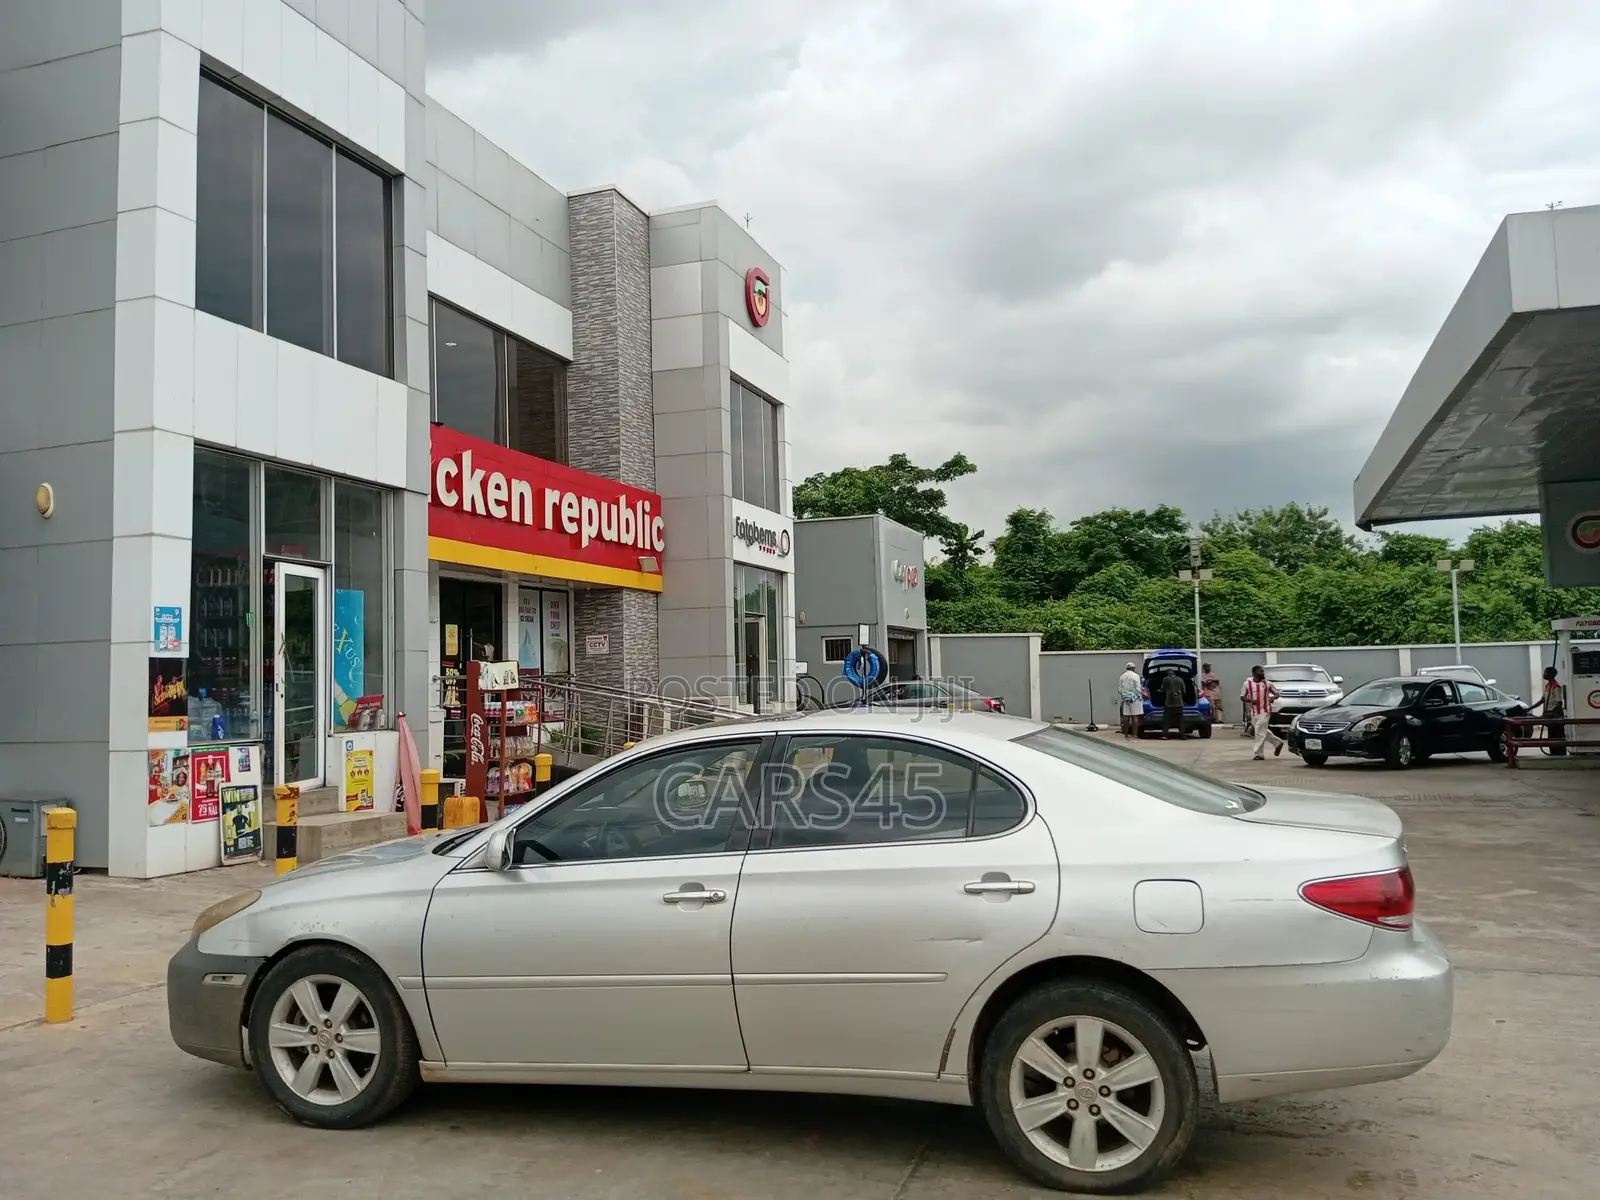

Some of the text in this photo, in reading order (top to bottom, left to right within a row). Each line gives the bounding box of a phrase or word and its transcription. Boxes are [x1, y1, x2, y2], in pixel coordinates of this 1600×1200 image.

[429, 438, 666, 553] cken republic
[222, 787, 240, 804] WIN
